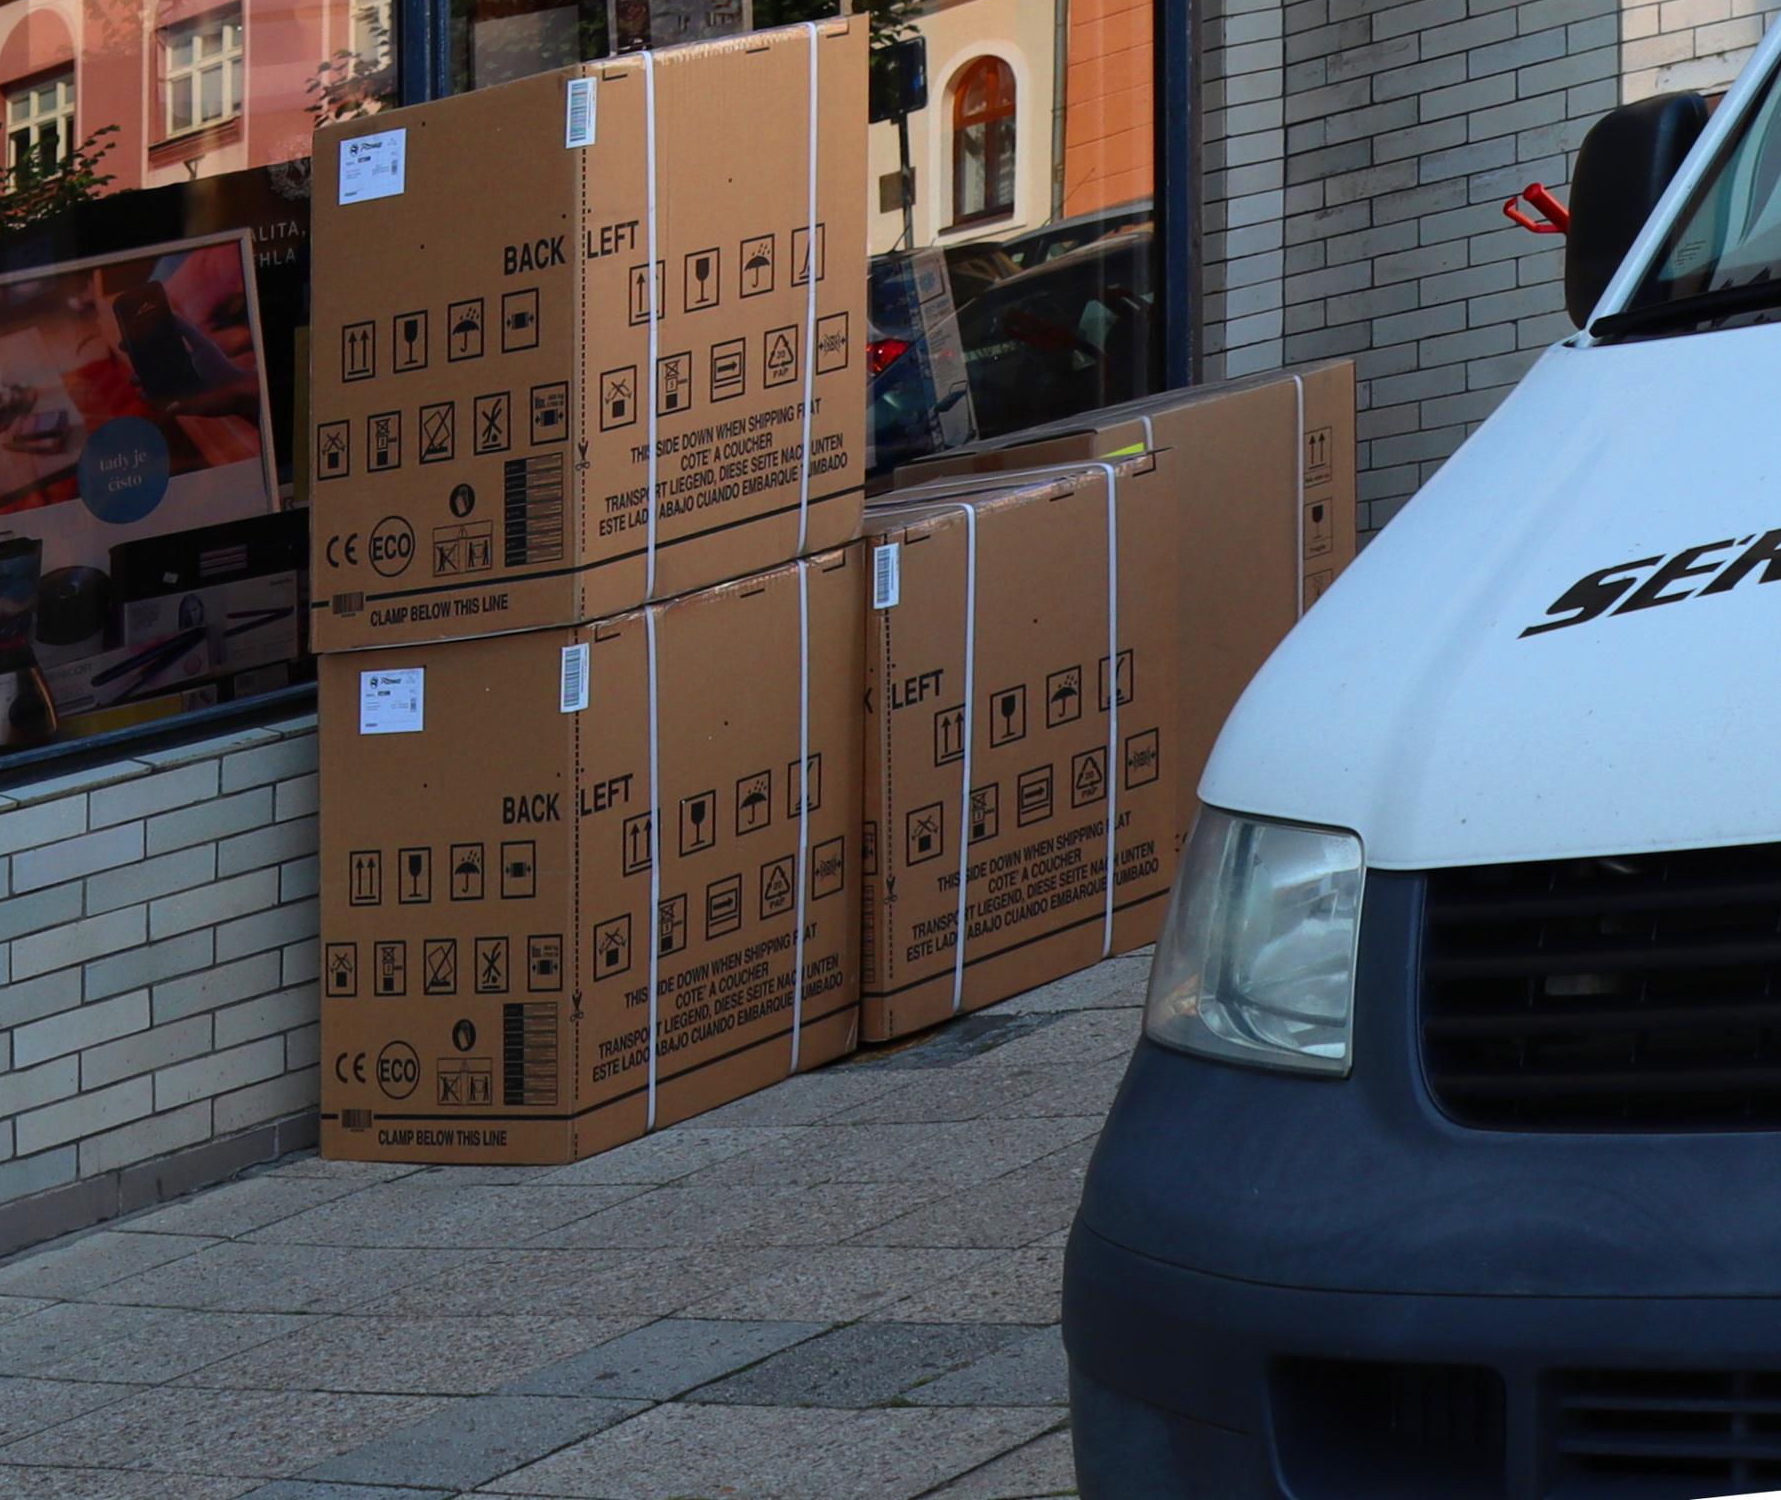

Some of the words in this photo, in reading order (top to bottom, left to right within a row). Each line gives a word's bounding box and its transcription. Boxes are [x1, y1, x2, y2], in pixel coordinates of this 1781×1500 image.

[253, 247, 297, 268] HLA
[504, 235, 567, 276] BACK
[586, 219, 640, 259] LEFT
[656, 436, 680, 457] SIDE
[682, 427, 714, 450] DOWN
[716, 418, 746, 440] WHEN
[748, 406, 795, 432] SHIPPING
[723, 432, 773, 460] COUCHER
[100, 453, 129, 472] tady
[132, 448, 148, 468] je
[605, 481, 668, 513] TRANSPRT
[670, 468, 717, 495] LIEGEND,
[719, 459, 749, 482] DIESE
[750, 451, 779, 473] SEITE
[781, 444, 805, 464] NAC
[811, 432, 844, 456] UNTEN
[599, 514, 626, 537] ESTE
[628, 508, 649, 528] LAD
[659, 495, 694, 519] ABAJO
[696, 483, 740, 509] CUANDO
[742, 466, 798, 496] EMBARQUE
[800, 452, 848, 478] UMBADO
[372, 533, 412, 561] ECO
[371, 609, 409, 627] CLAMP
[410, 603, 451, 622] BELOW
[453, 597, 480, 616] THIS
[482, 594, 509, 613] LINE
[891, 668, 944, 710] LEFT
[502, 792, 560, 825] BACK
[580, 773, 633, 817] LEFT
[989, 850, 1021, 874] DOWN
[1023, 838, 1054, 861] WHEN
[1056, 821, 1103, 850] SHIPPING
[1031, 848, 1082, 878] COUCHER
[1027, 875, 1057, 898] DIESE
[1059, 864, 1088, 887] SEITE
[1120, 840, 1155, 864] UNTEN
[907, 940, 933, 962] ESTE
[936, 931, 959, 951] LAD
[967, 915, 1002, 940] ABAJO
[1004, 898, 1048, 926] CUANDO
[1050, 876, 1108, 910] EMBARQUE
[624, 986, 648, 1009] THIS
[657, 977, 675, 996] IDE
[677, 963, 709, 989] DOWN
[711, 951, 742, 976] WHEN
[744, 933, 791, 964] SHIPPING
[793, 922, 817, 946] FAT
[718, 961, 769, 993] COUCHER
[599, 1021, 662, 1059] TRANSPOT
[714, 990, 744, 1015] DIESE
[746, 978, 775, 1003] SEITE
[806, 953, 839, 980] UNTEN
[593, 1058, 620, 1083] ESTE
[691, 1014, 735, 1044] CUANDO
[737, 990, 794, 1026] EMBARQUE
[800, 971, 843, 1001] UMBADO
[380, 1059, 417, 1083] ECO
[378, 1129, 414, 1146] CLAMP
[416, 1129, 454, 1146] BELOW
[456, 1130, 481, 1146] THIS
[483, 1130, 507, 1146] LINE
